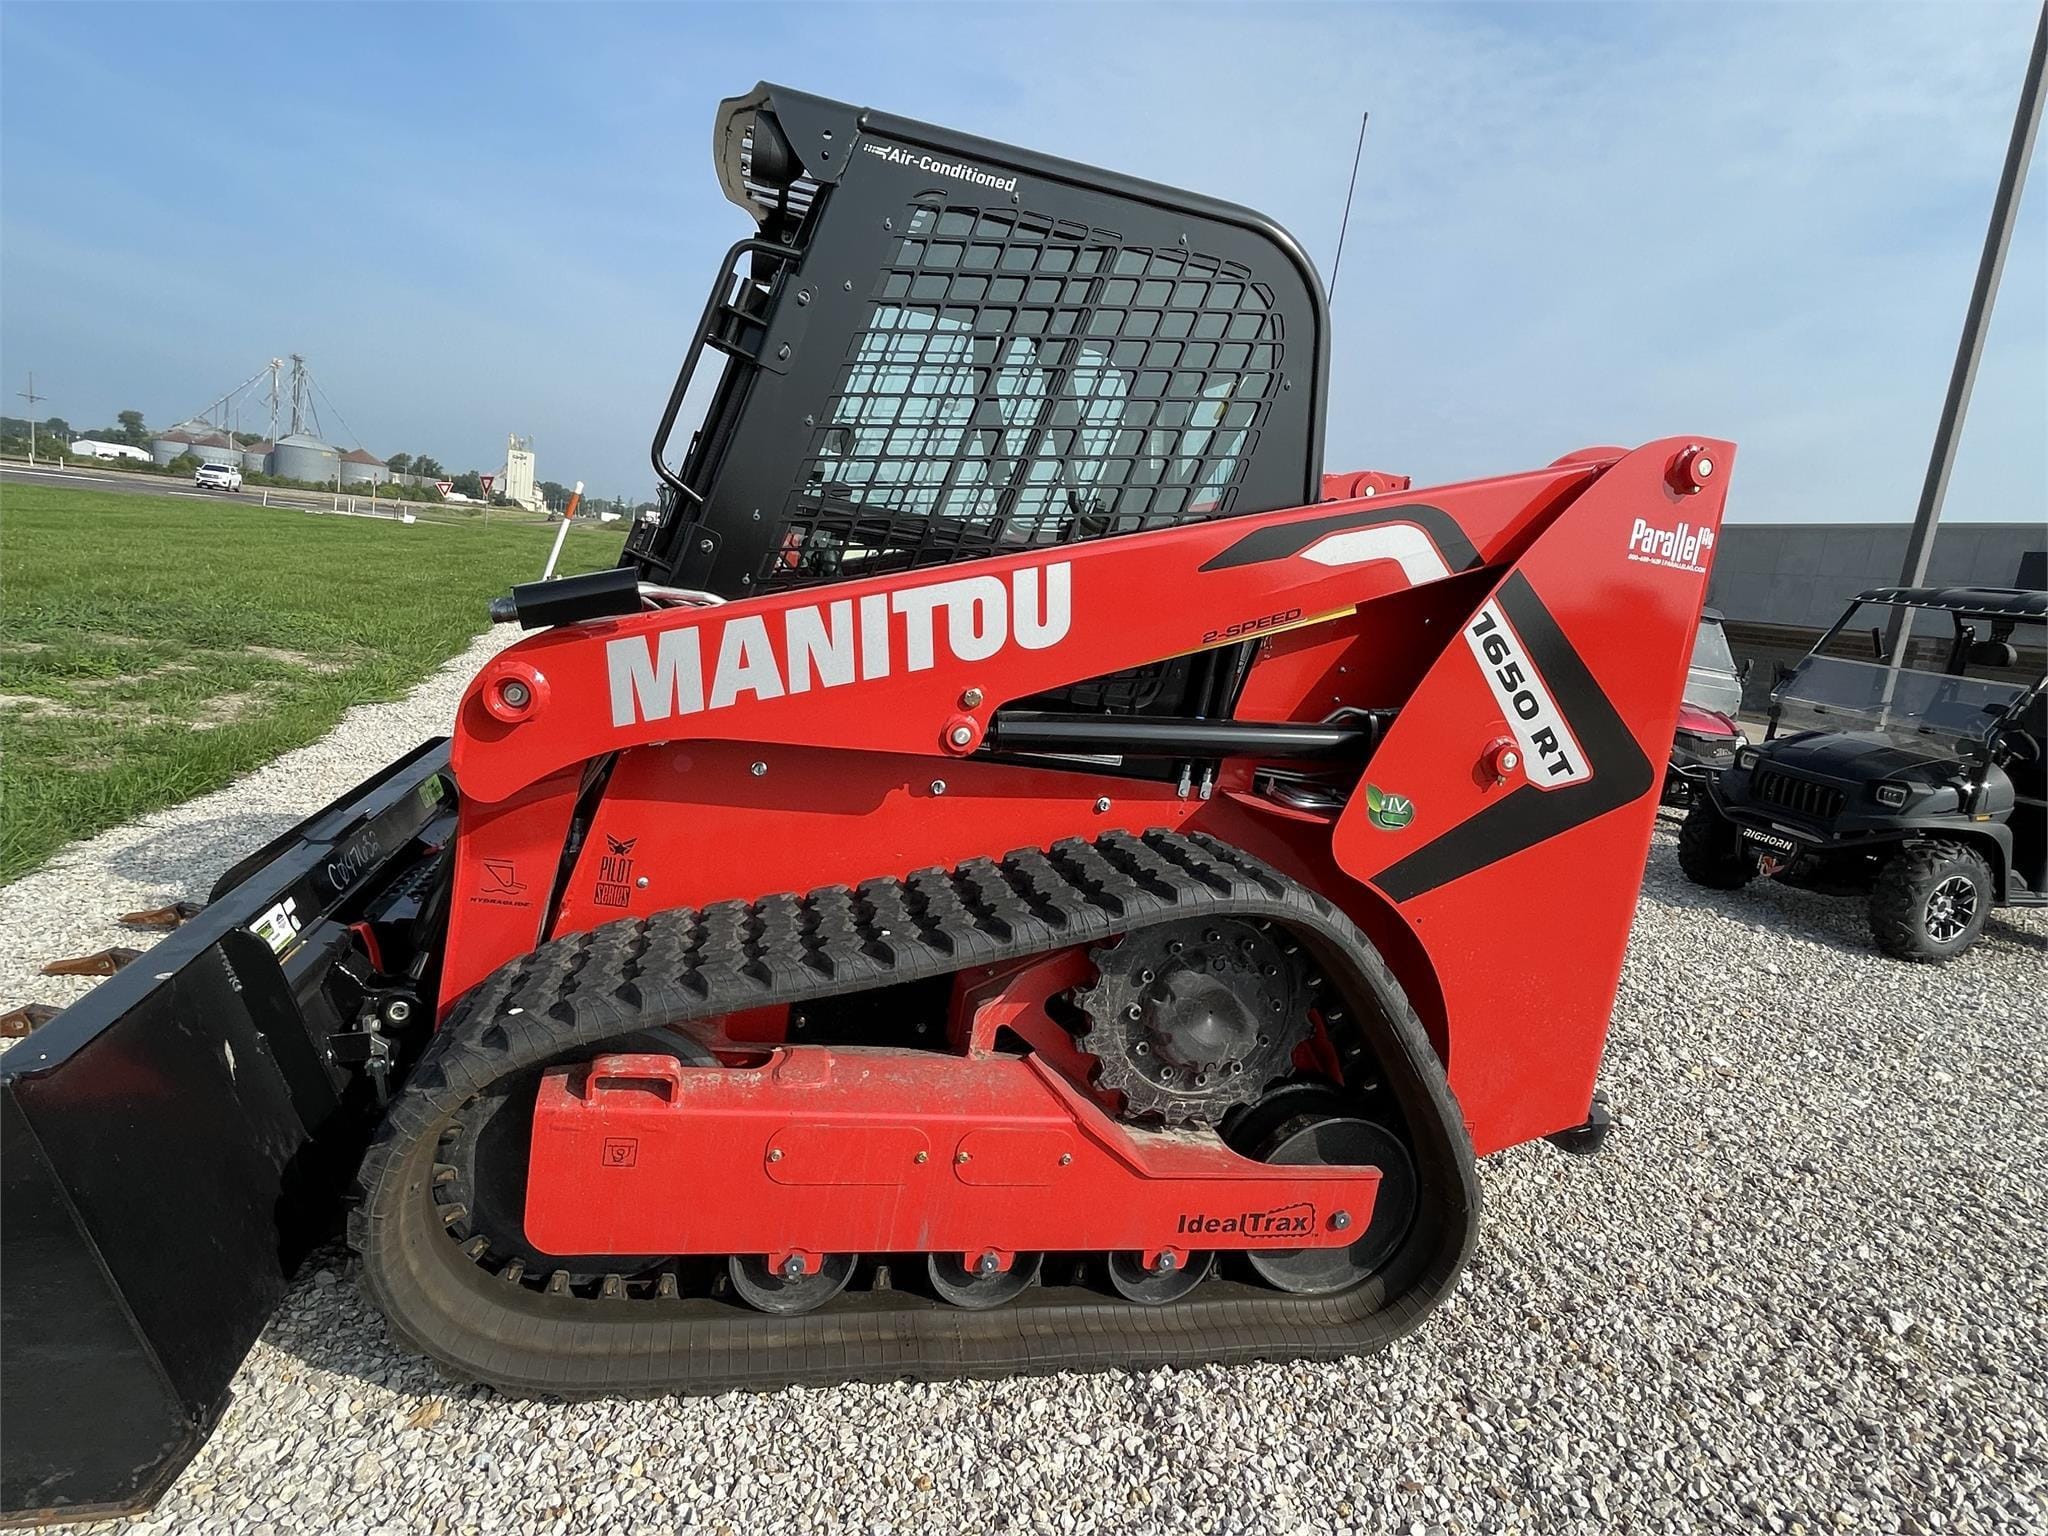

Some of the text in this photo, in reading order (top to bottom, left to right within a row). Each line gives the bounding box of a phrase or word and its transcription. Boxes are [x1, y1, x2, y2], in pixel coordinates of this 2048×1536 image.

[887, 148, 1017, 193] Air-Conditioned
[606, 561, 1071, 728] MANITOU
[1202, 608, 1302, 644] 2-SPEED
[1472, 610, 1575, 777] 1650 RT
[599, 856, 634, 884] PILOT
[1178, 1210, 1308, 1234] IdealTrax
